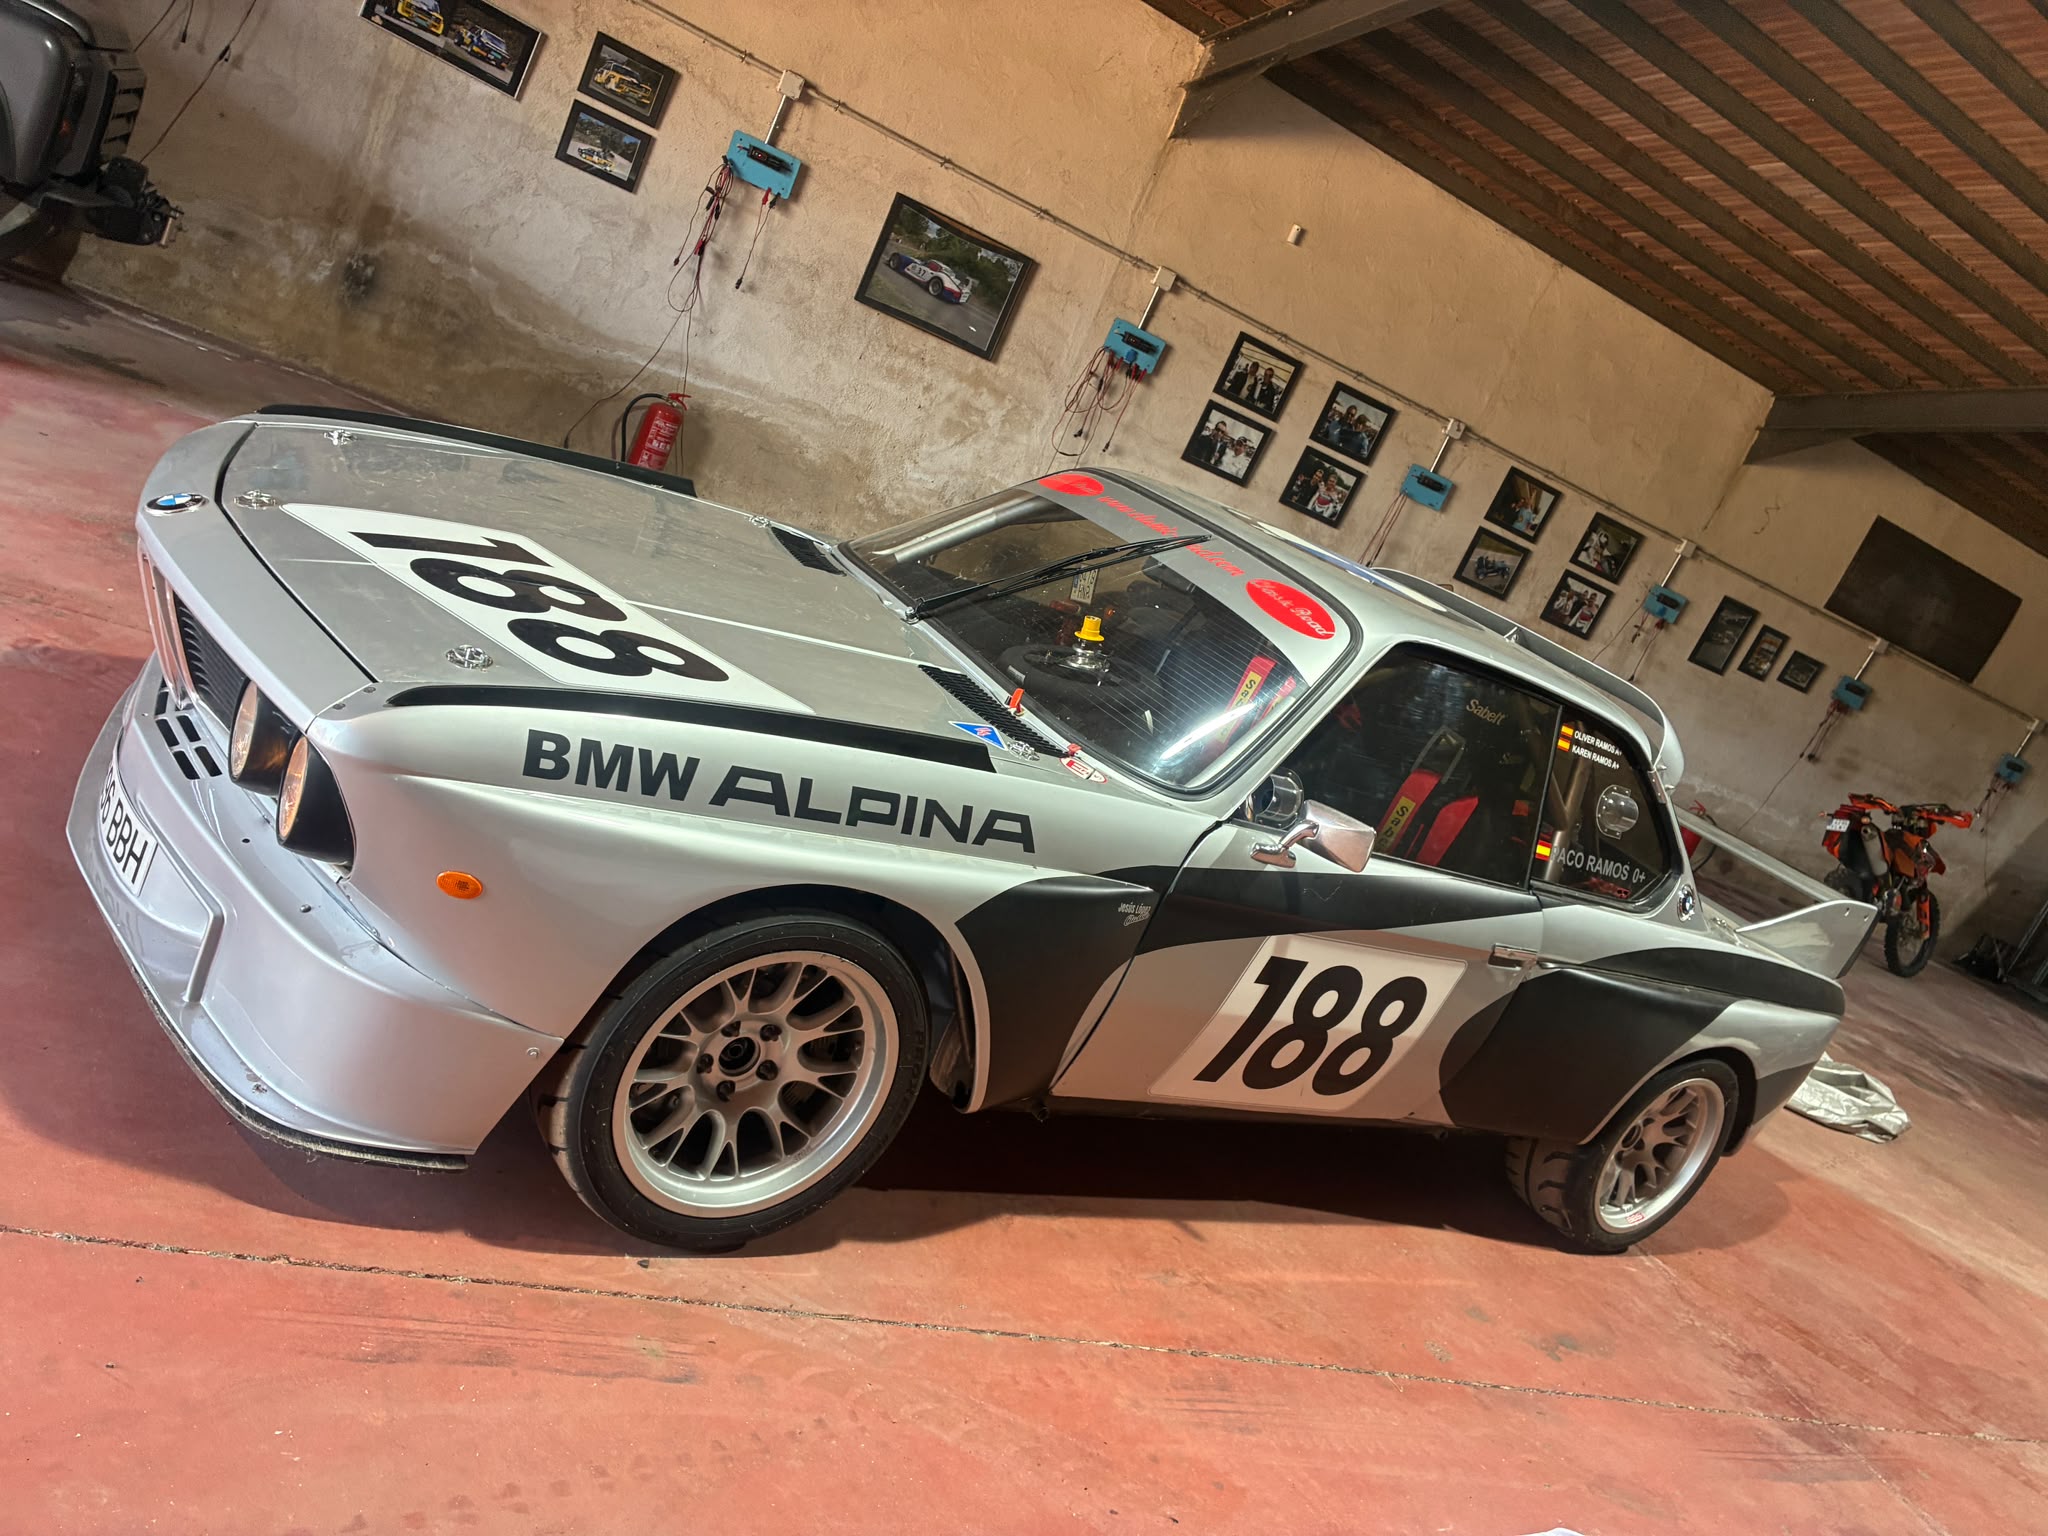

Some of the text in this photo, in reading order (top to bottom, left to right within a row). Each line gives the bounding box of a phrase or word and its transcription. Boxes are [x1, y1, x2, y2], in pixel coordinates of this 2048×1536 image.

[349, 531, 730, 682] 188
[1290, 607, 1335, 636] Road
[1466, 699, 1506, 726] Sabelt
[1571, 744, 1592, 760] KAREN
[1592, 751, 1612, 768] RAMOS
[1574, 729, 1595, 746] OLIVER
[1595, 737, 1616, 755] RAMOS
[522, 728, 1036, 854] BMW ALPINA
[106, 797, 149, 885] BBH
[1550, 845, 1585, 869] PACO
[1586, 855, 1630, 881] RAMOS
[1192, 955, 1428, 1096] 188
